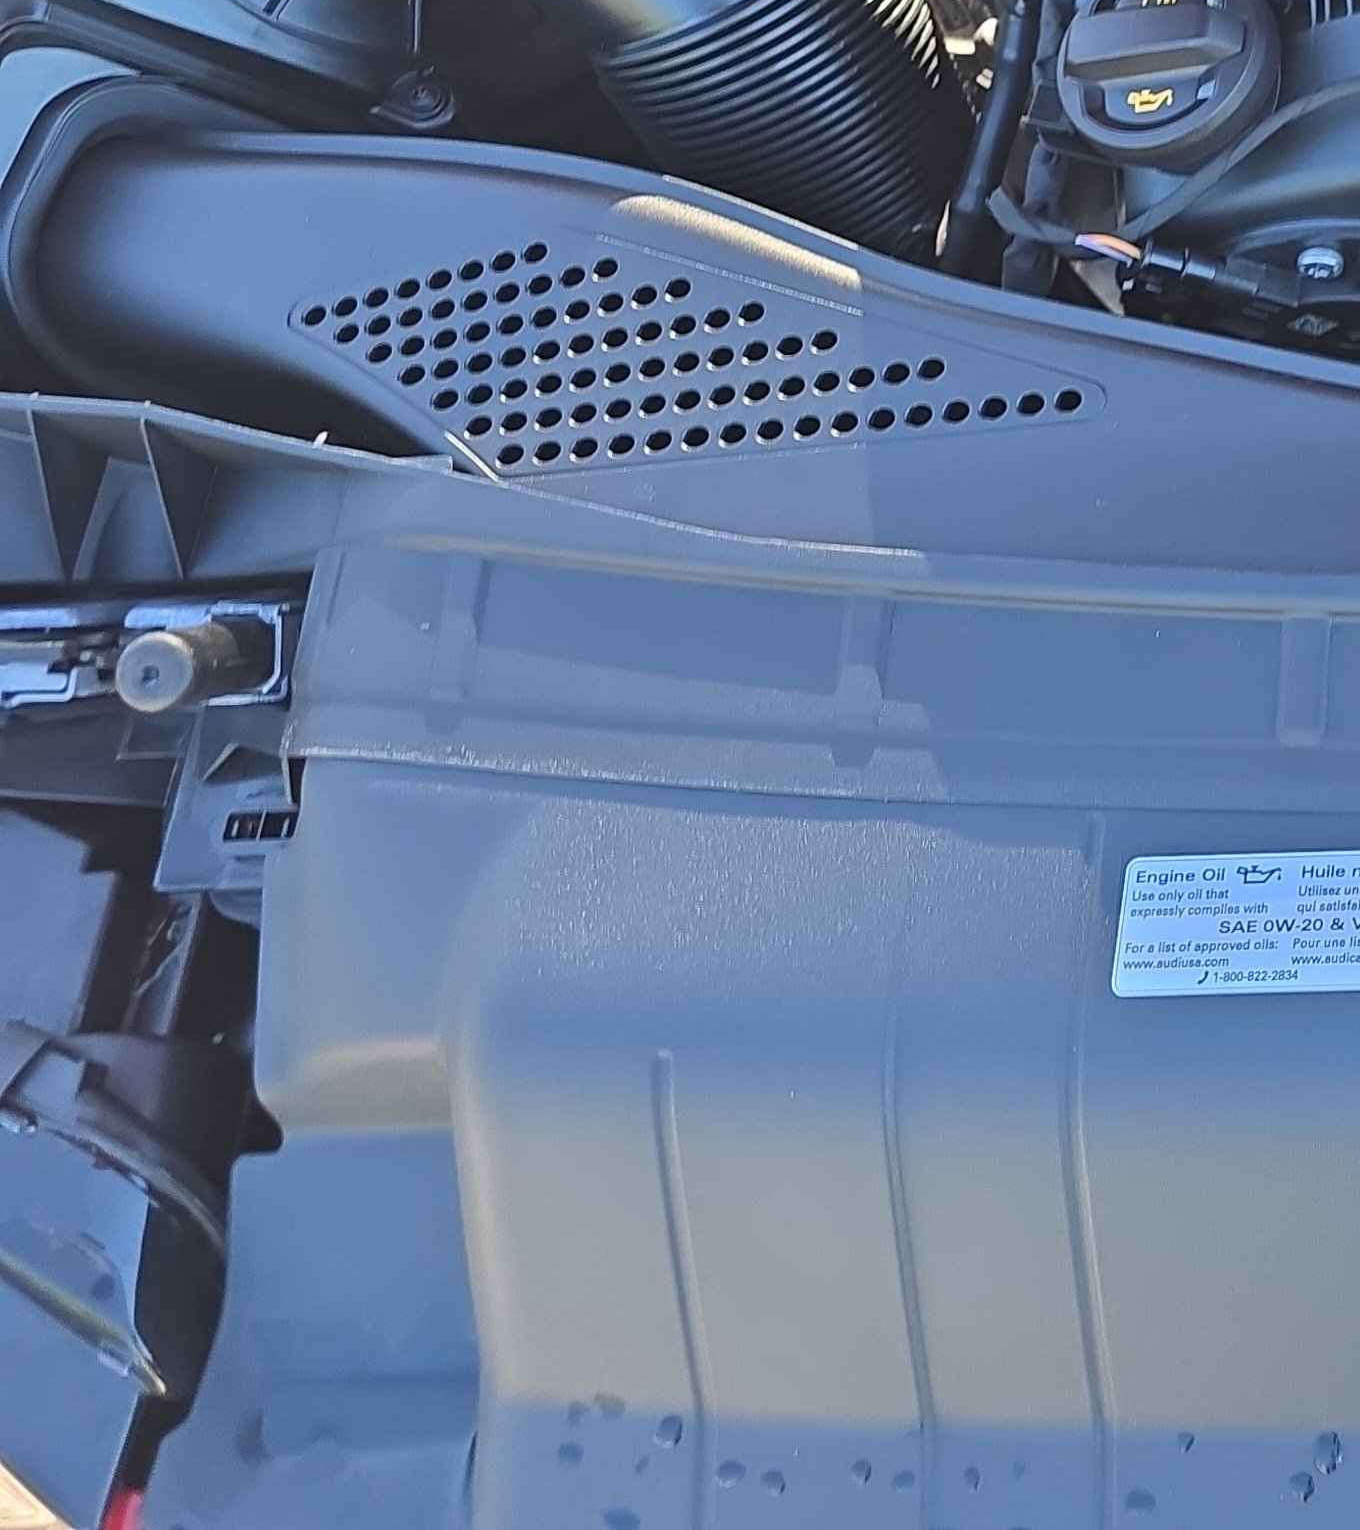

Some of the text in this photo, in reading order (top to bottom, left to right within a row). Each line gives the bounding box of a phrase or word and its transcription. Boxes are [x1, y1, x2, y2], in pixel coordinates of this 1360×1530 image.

[1136, 868, 1225, 885] Engine Oil
[1302, 864, 1346, 879] Huile
[1132, 888, 1229, 903] Use only oil that
[1298, 884, 1341, 897] Utilisez
[1130, 902, 1268, 919] expressly complies with
[1297, 900, 1316, 914] qui
[1218, 920, 1258, 934] SAE
[1263, 918, 1324, 933] 0W-20
[1330, 918, 1345, 931] &
[1124, 938, 1280, 954] For a list of approved oils:
[1292, 937, 1320, 949] Pour
[1324, 938, 1345, 948] une
[1123, 956, 1230, 970] www.audiusa.com
[1213, 970, 1298, 983] 1-800-822-2834
